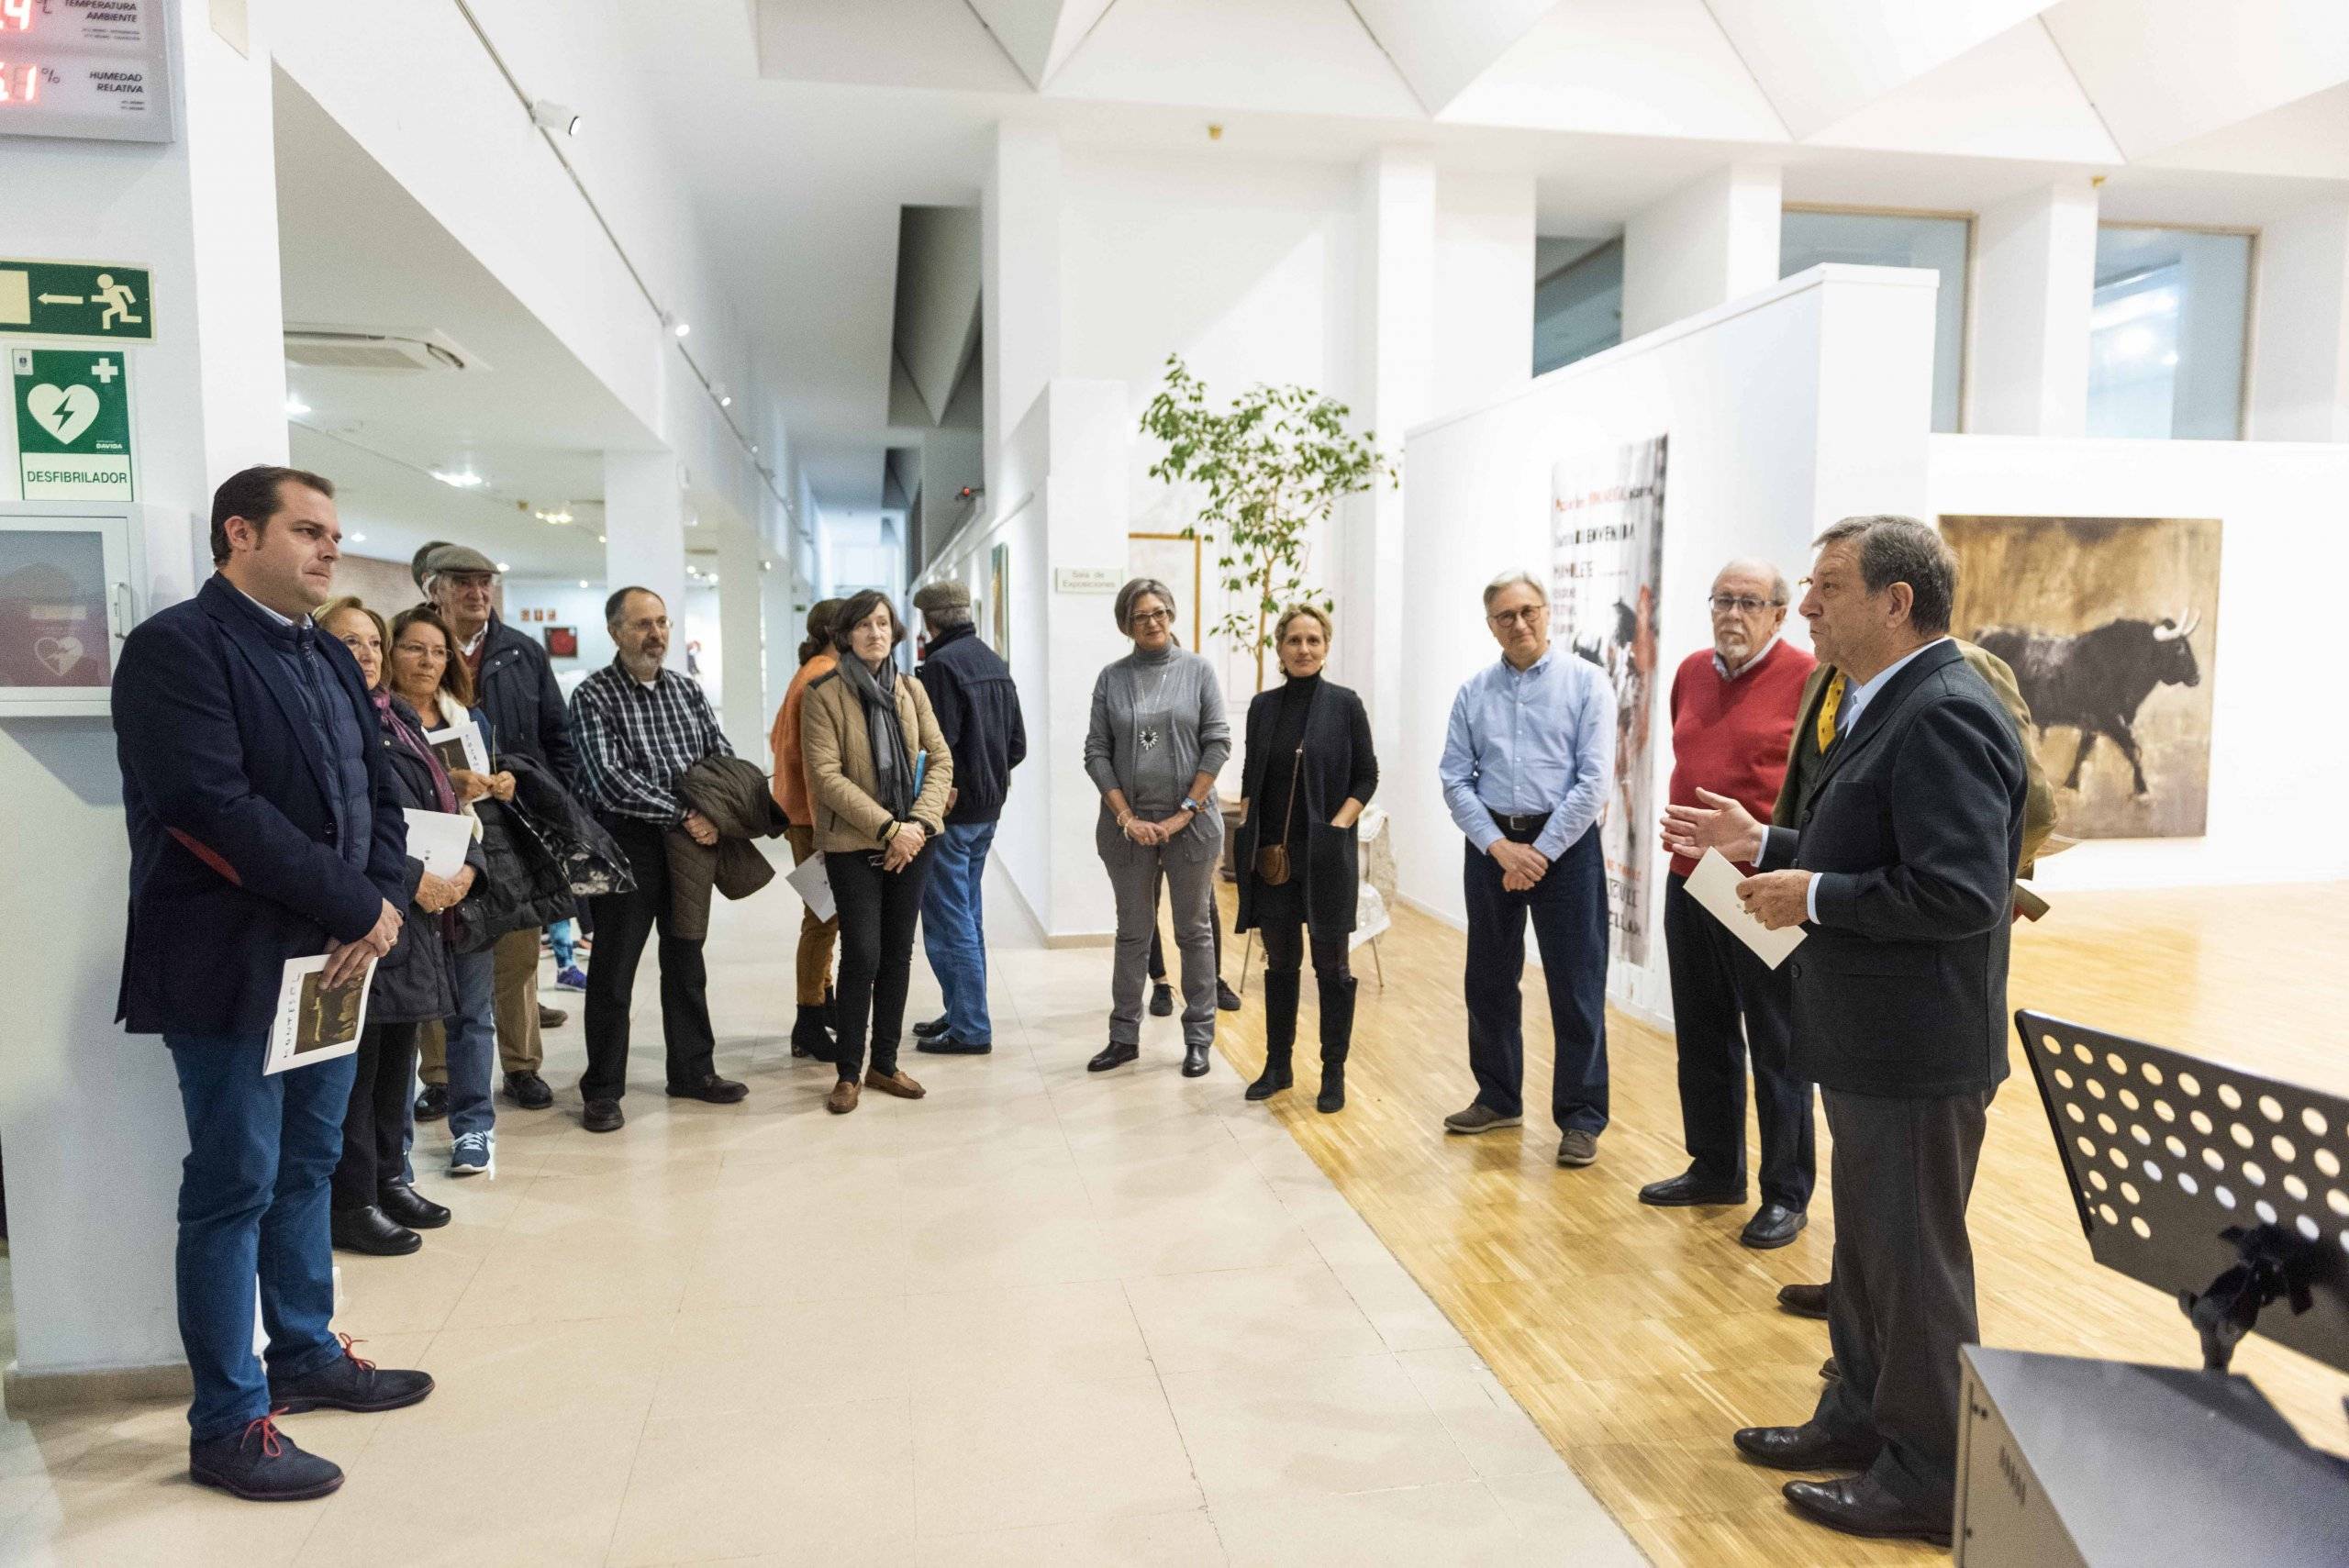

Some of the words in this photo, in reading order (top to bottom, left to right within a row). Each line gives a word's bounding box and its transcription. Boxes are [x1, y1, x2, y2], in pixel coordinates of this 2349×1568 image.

[64, 0, 137, 11] TEMPERATURA
[85, 12, 137, 23] AMBIENTE
[89, 71, 143, 82] HUMEDAD
[96, 83, 144, 93] RELATIVA
[27, 471, 128, 484] DESFIBRILADOR
[1072, 570, 1090, 578] Sala
[1062, 579, 1116, 589] Exposiciones
